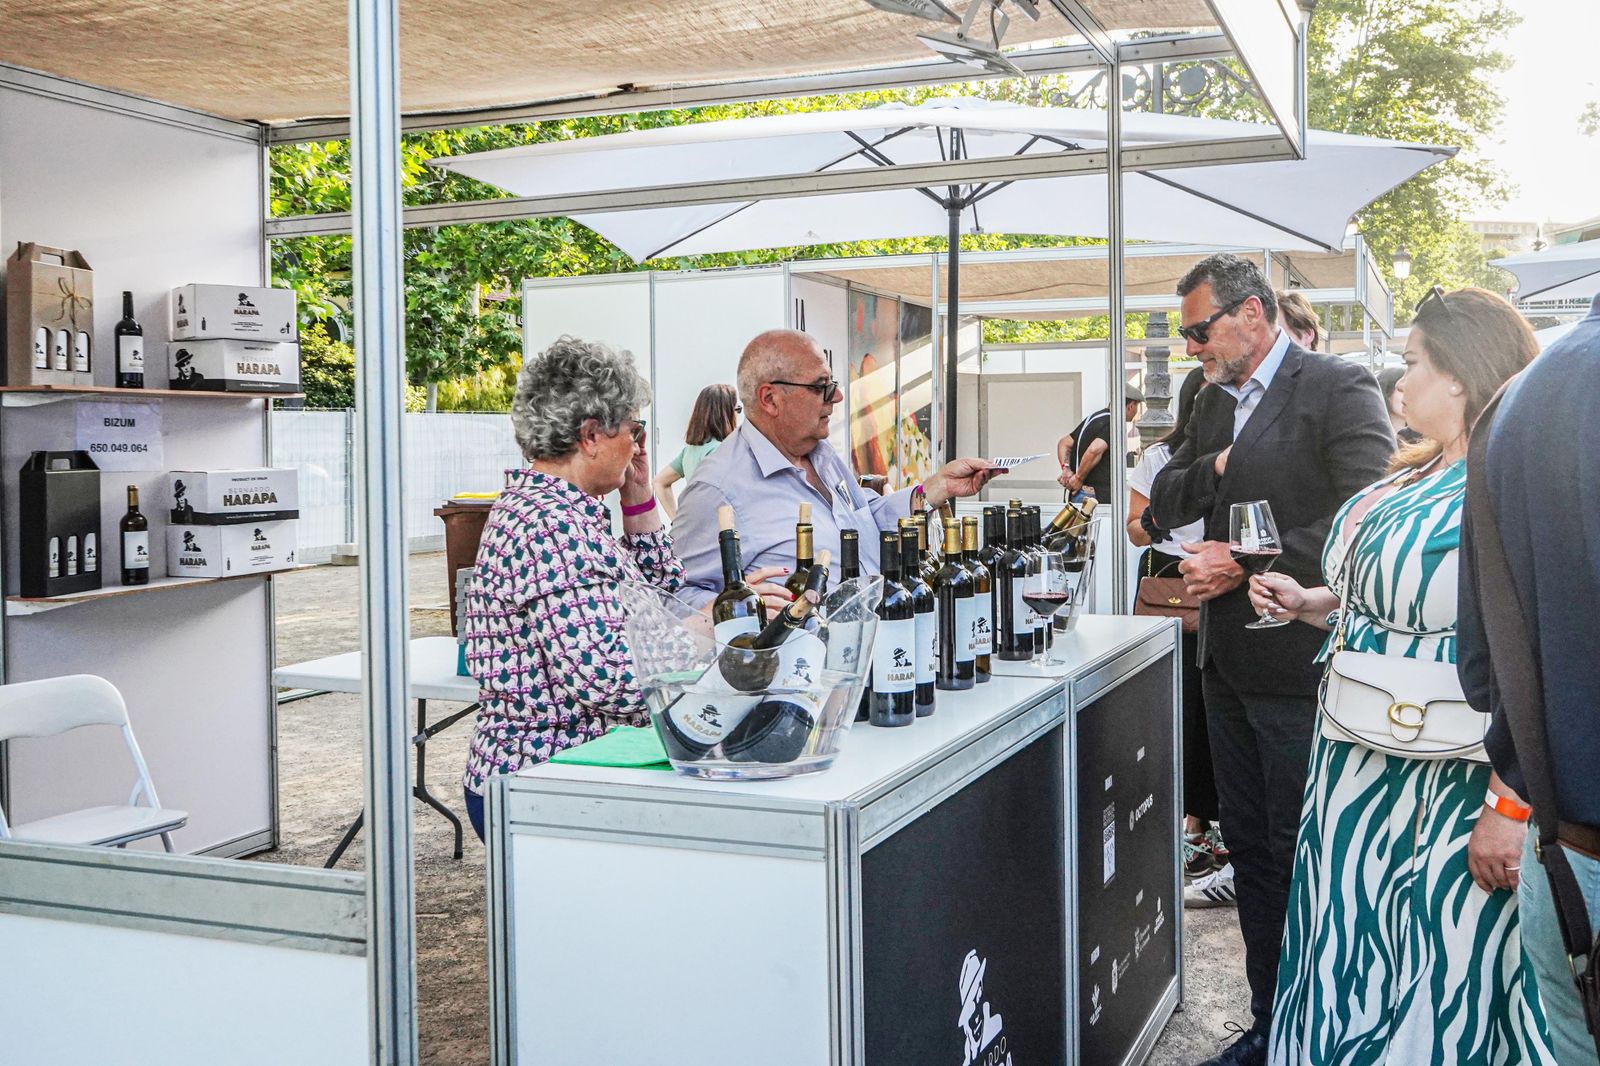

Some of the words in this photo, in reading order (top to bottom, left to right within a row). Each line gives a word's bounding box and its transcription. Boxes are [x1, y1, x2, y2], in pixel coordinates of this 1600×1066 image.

[236, 362, 281, 375] HARAPA
[103, 417, 136, 427] BIZUM
[90, 443, 148, 452] 650.049.064
[223, 492, 278, 506] HARAPA
[179, 557, 207, 566] HARAPA
